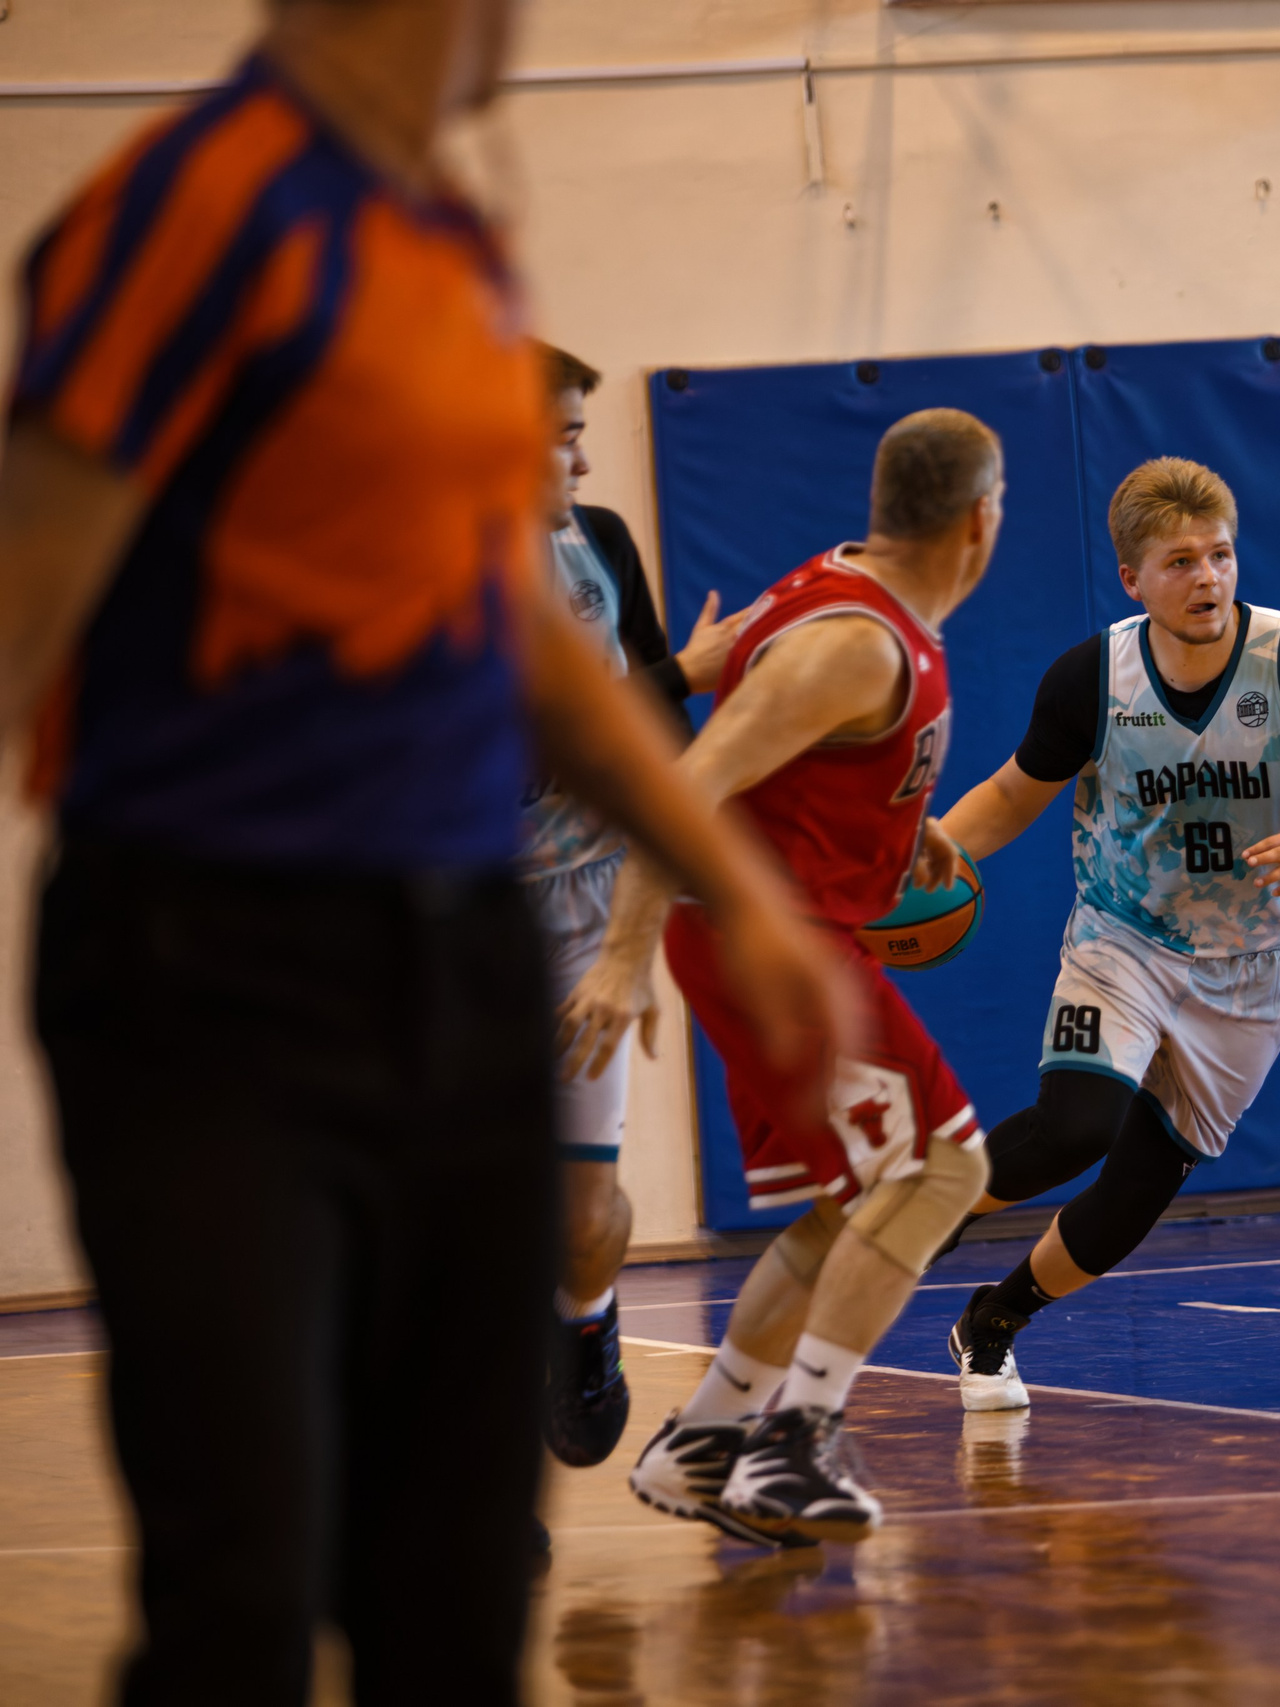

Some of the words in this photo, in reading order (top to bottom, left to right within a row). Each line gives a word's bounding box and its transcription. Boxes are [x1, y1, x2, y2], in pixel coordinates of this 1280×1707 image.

[1115, 711, 1166, 727] fruitit
[1136, 759, 1271, 807] ВАРАНЫ
[1184, 821, 1233, 873] 69
[888, 937, 919, 952] FIBA
[1053, 1004, 1101, 1054] 69
